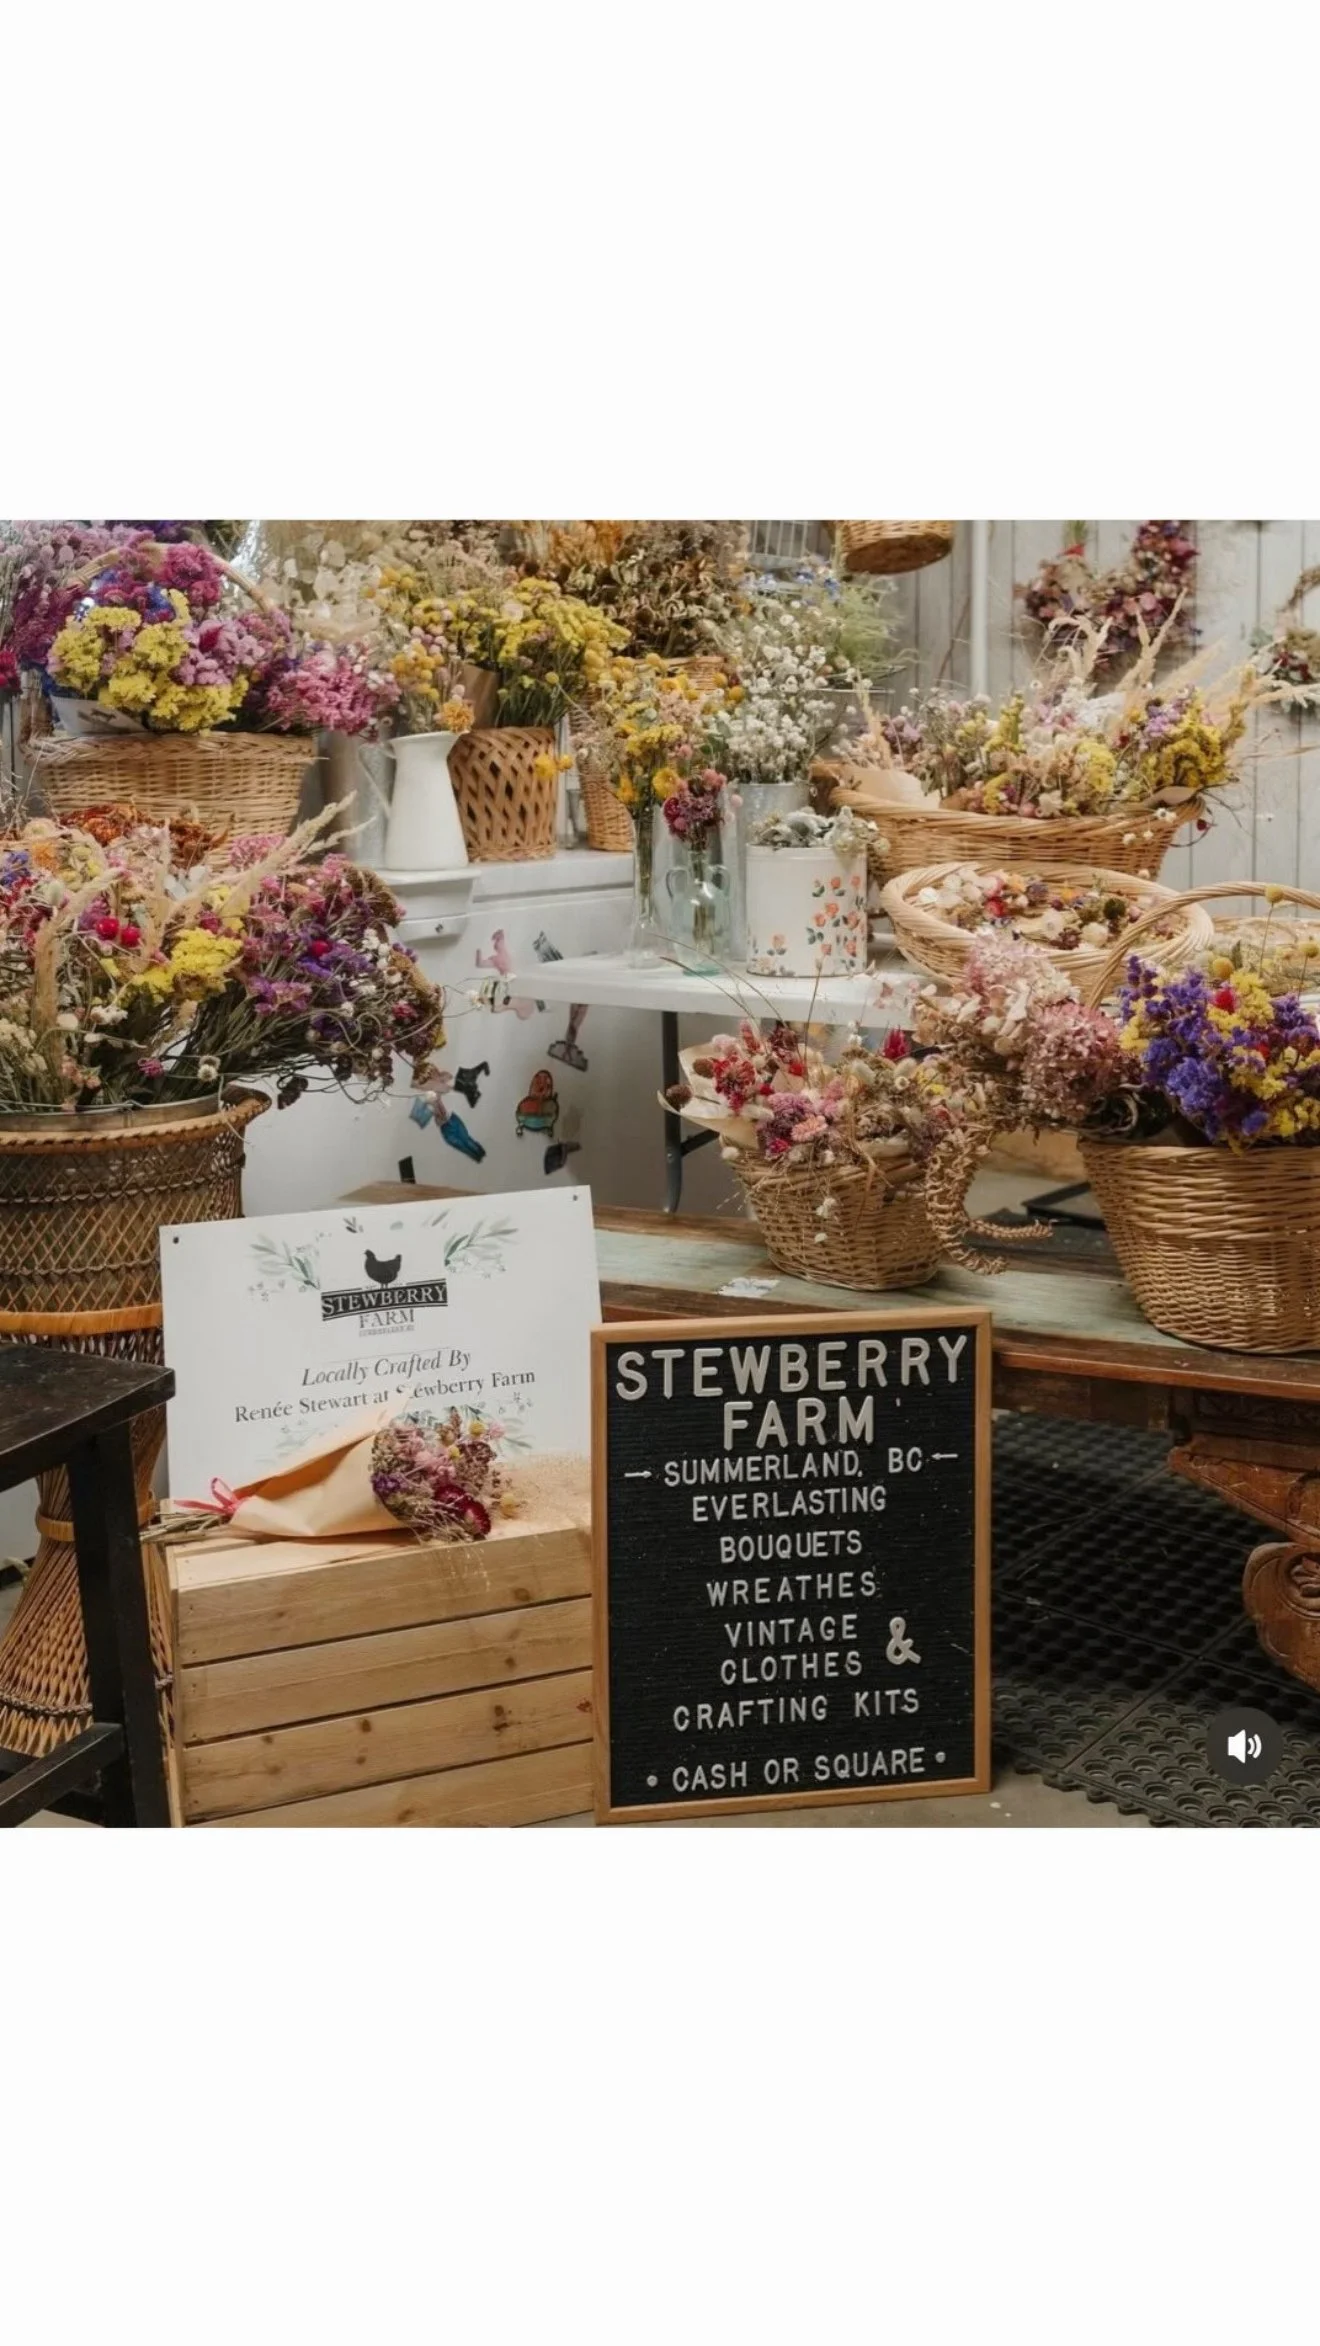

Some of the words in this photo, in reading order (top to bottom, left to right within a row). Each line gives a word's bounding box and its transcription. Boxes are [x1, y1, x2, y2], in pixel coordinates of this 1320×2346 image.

[321, 1285, 447, 1316] STEWBERRY
[359, 1308, 415, 1329] FARM
[301, 1360, 369, 1386] Locally
[374, 1350, 442, 1379] Crafted
[449, 1349, 471, 1372] By
[615, 1334, 968, 1401] STEWBERRY
[234, 1401, 294, 1423] Renée
[299, 1392, 368, 1414] Stewart
[372, 1389, 390, 1405] at
[491, 1370, 536, 1388] Farm
[722, 1395, 875, 1451] FARM
[887, 1446, 924, 1475] BC
[692, 1485, 887, 1522] EVERLASTING
[720, 1529, 863, 1564] BOUQUETS
[706, 1571, 878, 1608] WREATHES
[724, 1613, 859, 1648] VINTAGE
[885, 1616, 922, 1666] &
[720, 1650, 864, 1686] CLOTHES
[673, 1694, 829, 1733] CRAFTING
[854, 1688, 920, 1718] KITS
[672, 1761, 749, 1793] CASH
[763, 1757, 800, 1785] OR
[814, 1747, 926, 1782] SQUARE
